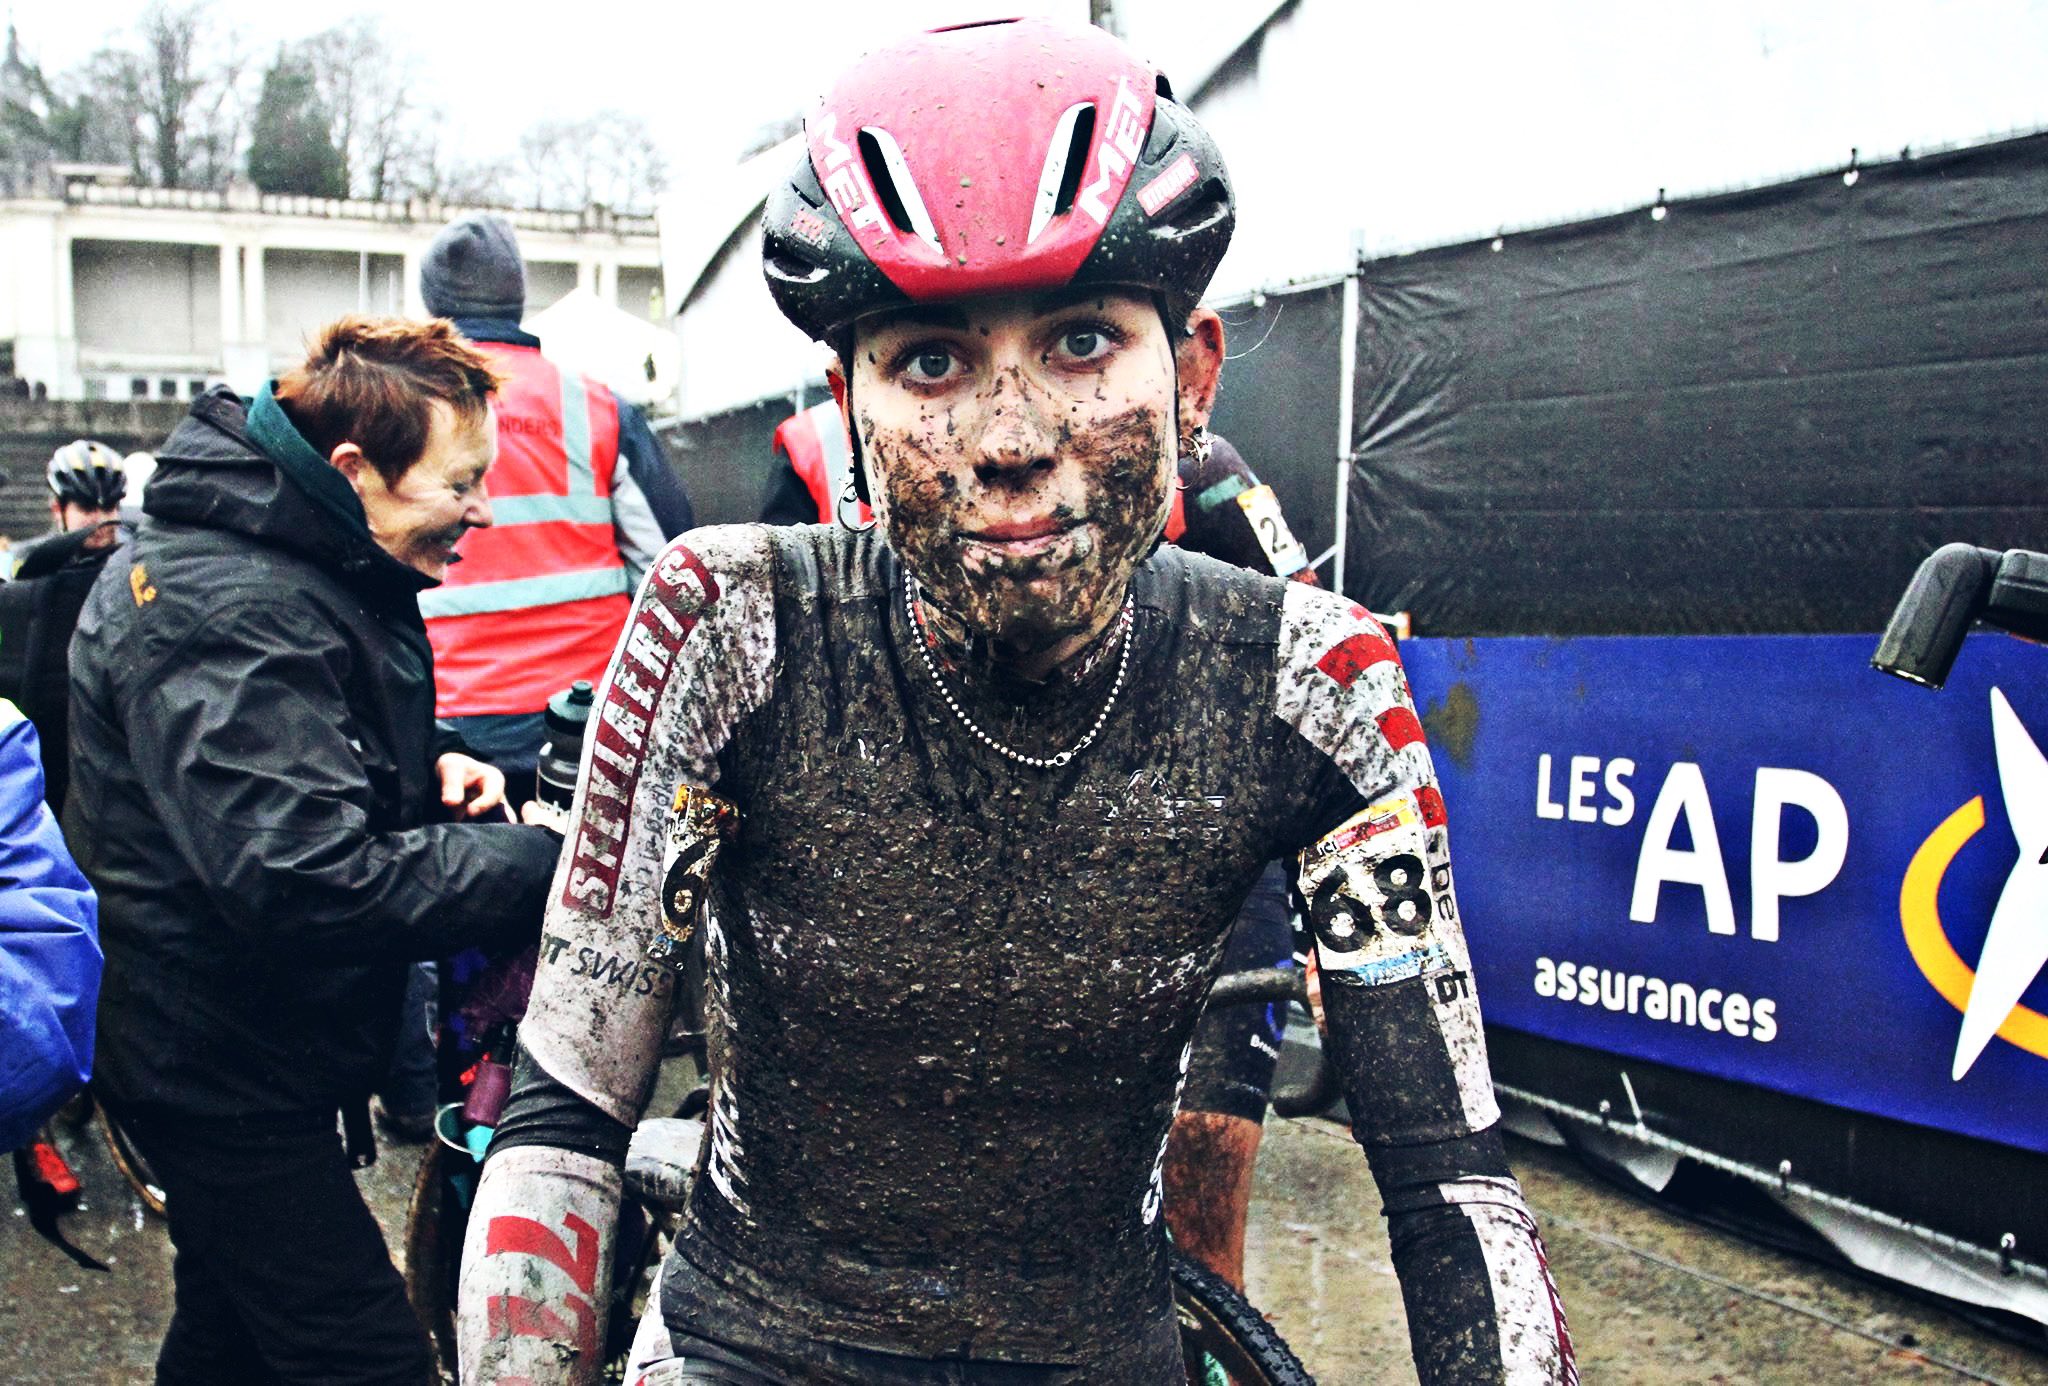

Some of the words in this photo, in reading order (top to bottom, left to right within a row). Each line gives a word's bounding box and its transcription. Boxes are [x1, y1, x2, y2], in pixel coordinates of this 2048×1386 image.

[813, 111, 891, 235] MET
[1077, 75, 1148, 225] MET
[1311, 854, 1432, 953] 68
[1536, 753, 1636, 827] LES
[1629, 761, 1849, 943] AP
[1434, 970, 1470, 1004] DT
[1534, 957, 1778, 1043] assurances
